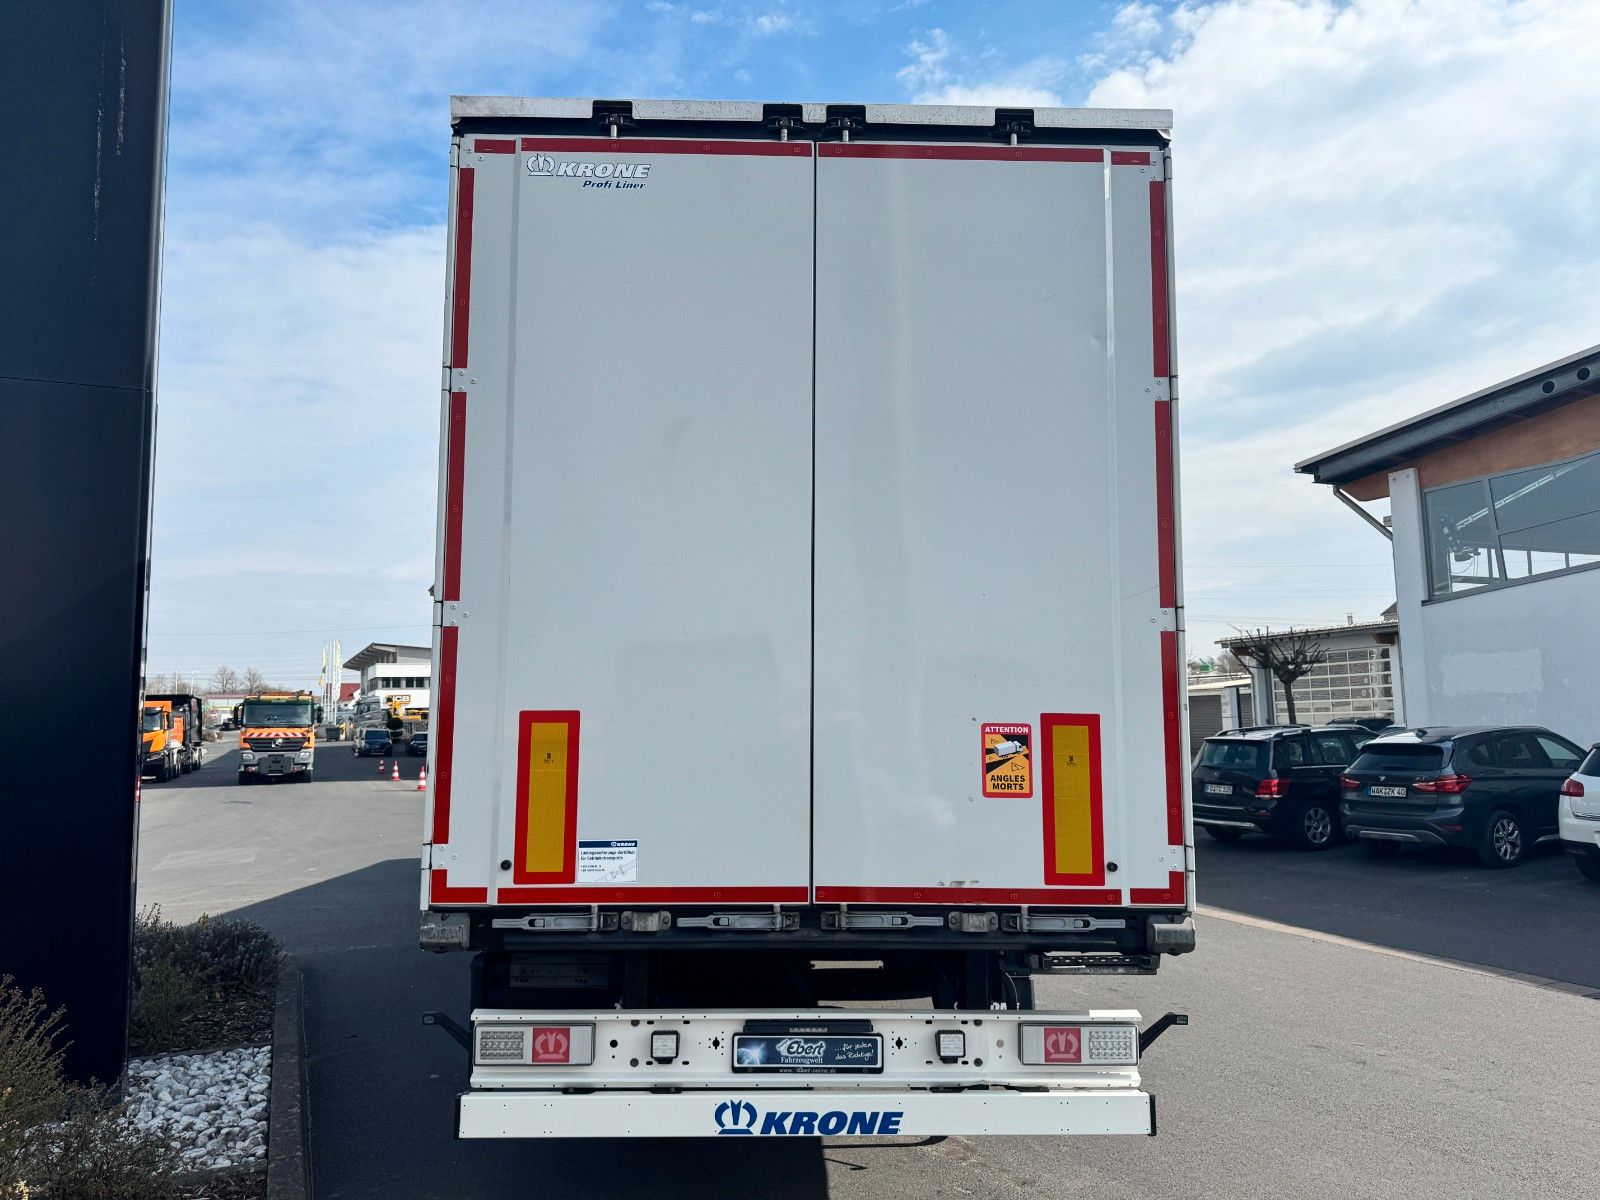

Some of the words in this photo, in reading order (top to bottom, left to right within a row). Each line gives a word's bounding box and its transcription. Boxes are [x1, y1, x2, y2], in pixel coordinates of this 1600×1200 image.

[556, 162, 651, 178] KRONE
[583, 180, 612, 189] Profi
[616, 181, 646, 189] Liner
[990, 775, 1025, 783] ANGLES
[786, 1040, 825, 1055] Ebert
[759, 1111, 904, 1136] KRONE
